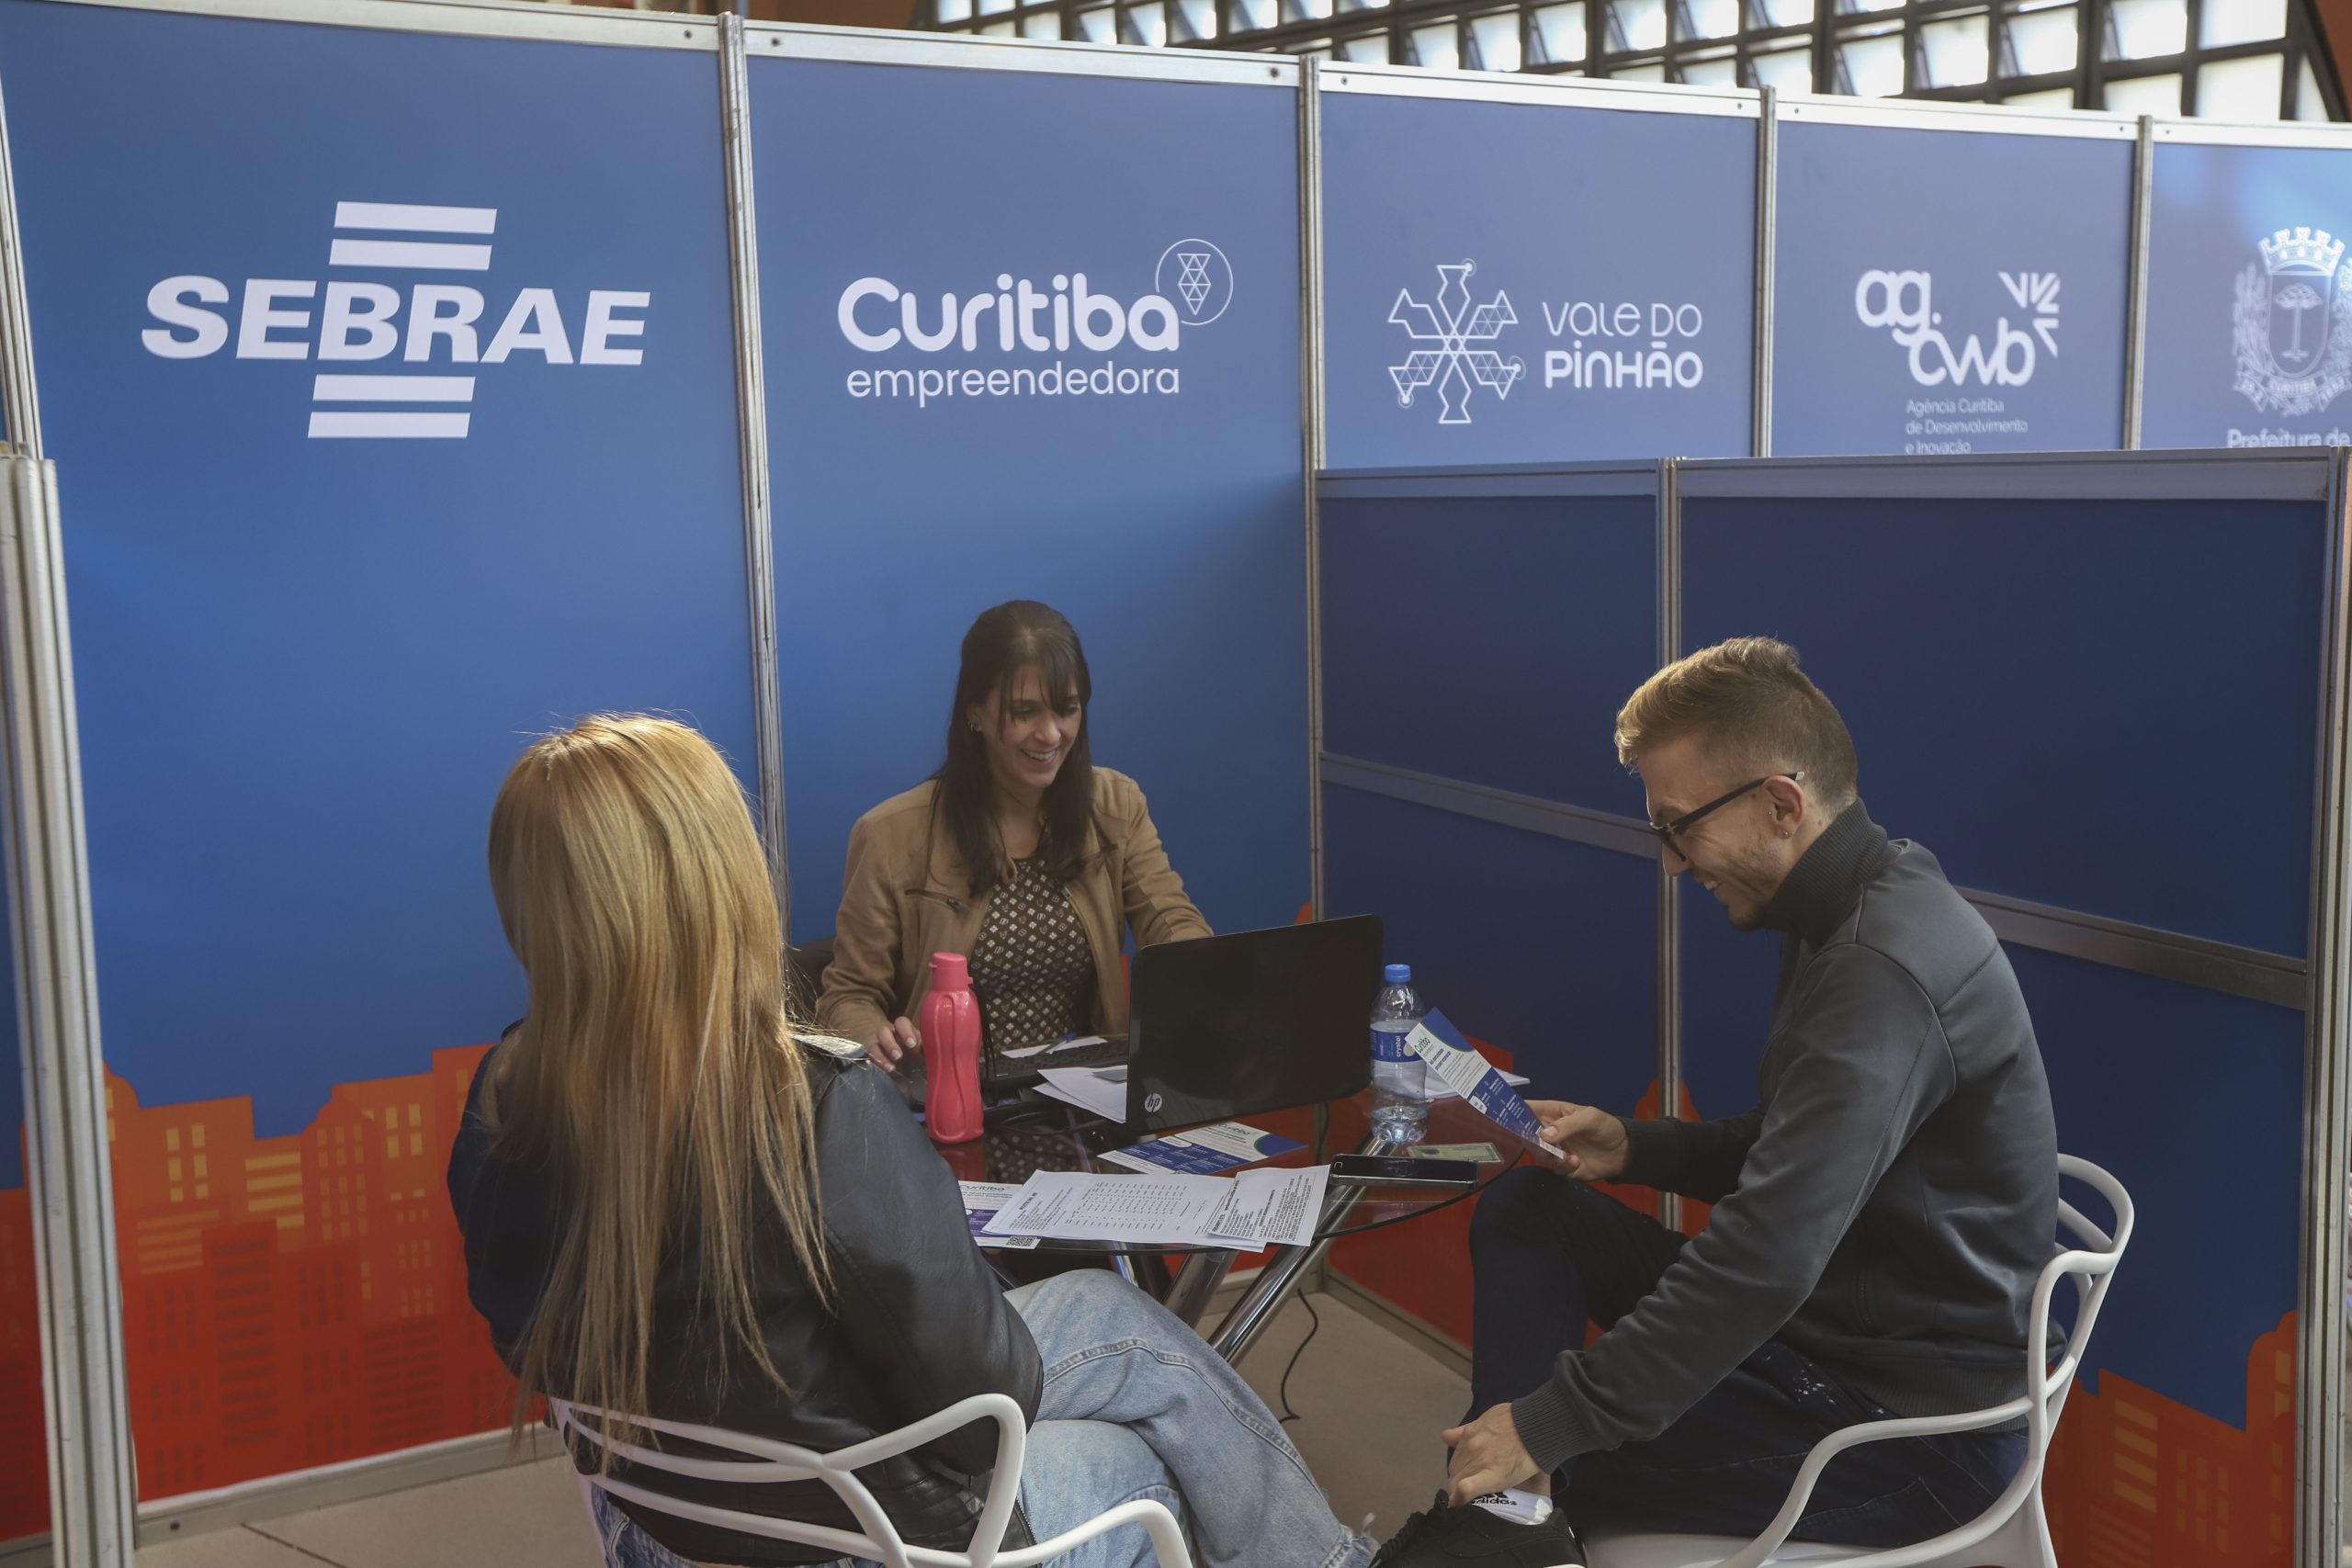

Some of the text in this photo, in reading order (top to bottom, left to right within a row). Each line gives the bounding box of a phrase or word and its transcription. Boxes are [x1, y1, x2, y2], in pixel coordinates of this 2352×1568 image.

[141, 275, 650, 366] SEBRAE
[837, 273, 1180, 352] Curitiba
[1651, 303, 1702, 337] DO
[1908, 317, 2036, 386] cwb
[846, 360, 1180, 408] empreendedora
[1906, 397, 2005, 417] Agência Curitiba
[1905, 419, 2029, 434] de Desenvolvimento
[2227, 427, 2351, 447] Prefeitura de
[1905, 439, 1972, 455] e Inovação
[1147, 1093, 1161, 1112] hp
